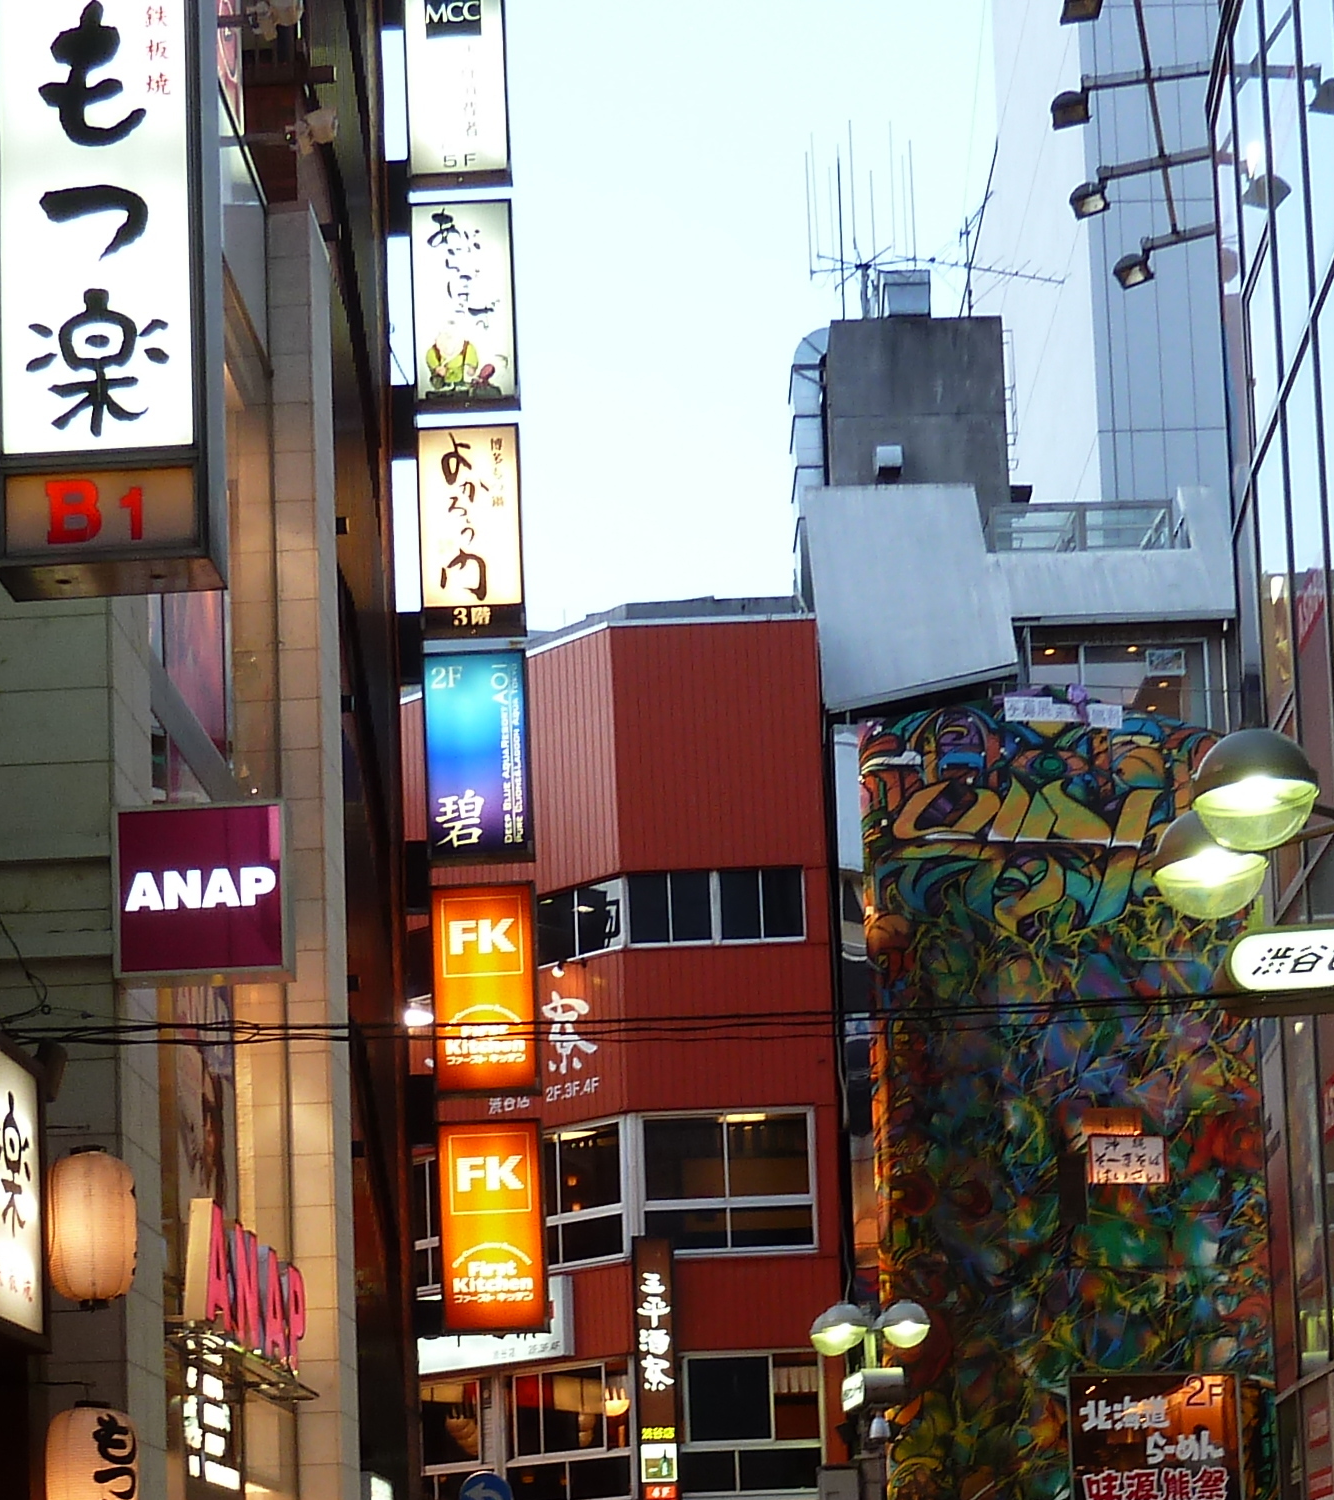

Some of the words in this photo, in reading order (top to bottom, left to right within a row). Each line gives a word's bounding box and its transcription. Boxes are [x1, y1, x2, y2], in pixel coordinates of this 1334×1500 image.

[426, 1, 480, 24] MCC
[25, 0, 169, 437] もつ楽
[44, 479, 144, 545] B1
[453, 606, 491, 626] 3階
[431, 666, 462, 690] 2F
[436, 789, 485, 848] 碧
[125, 866, 276, 912] ANAP
[448, 918, 516, 955] FK
[456, 1155, 525, 1193] FK
[453, 1276, 533, 1292] Kitchen
[468, 1260, 517, 1277] First
[206, 1200, 306, 1378] ANAP
[1183, 1374, 1225, 1407] 2F
[1079, 1395, 1171, 1432] 北海道
[1146, 1430, 1225, 1465] らーめん
[651, 1487, 671, 1498] 4F
